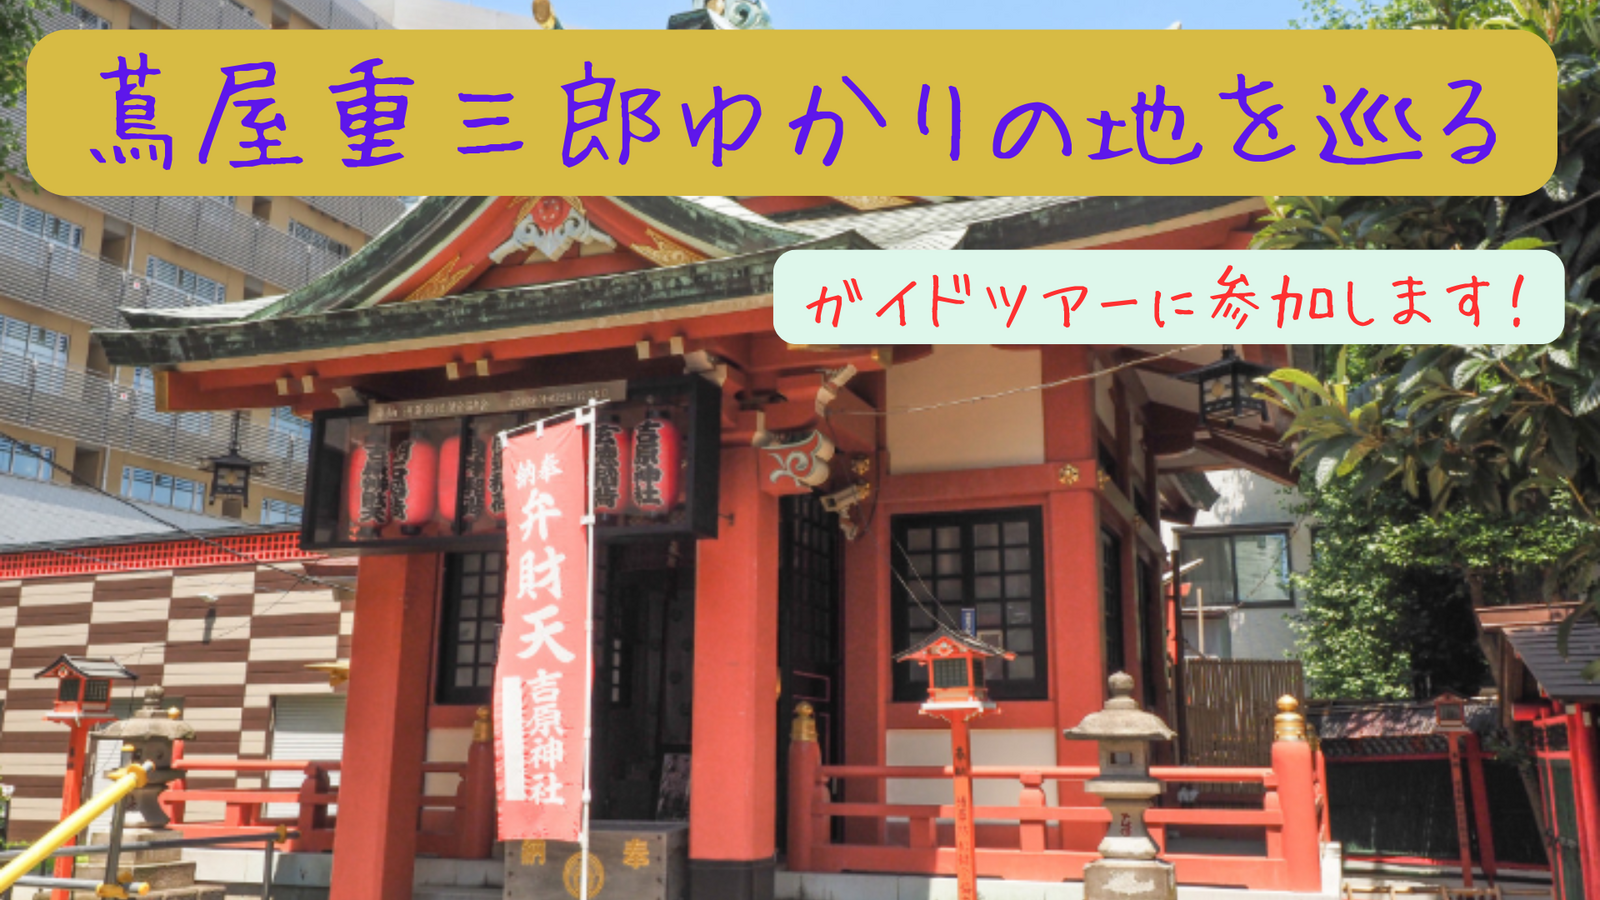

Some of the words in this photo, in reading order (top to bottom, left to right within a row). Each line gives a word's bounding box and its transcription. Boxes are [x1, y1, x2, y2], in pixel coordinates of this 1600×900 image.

[515, 453, 563, 489] 奉納
[634, 419, 664, 507] 吉原神社
[516, 487, 576, 663] 弁財天
[524, 668, 566, 806] 吉原神社
[622, 838, 650, 870] 奉
